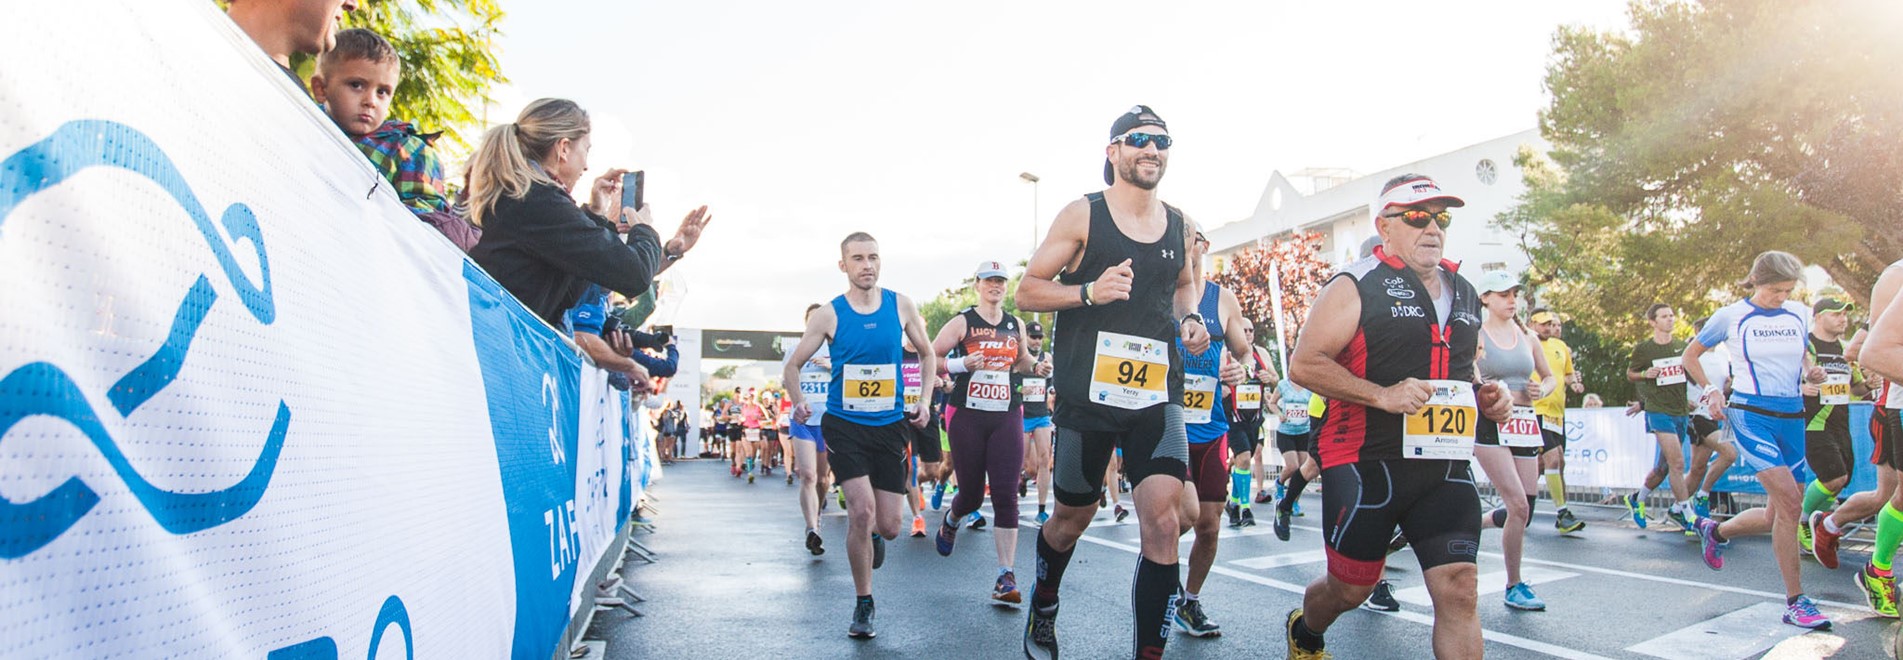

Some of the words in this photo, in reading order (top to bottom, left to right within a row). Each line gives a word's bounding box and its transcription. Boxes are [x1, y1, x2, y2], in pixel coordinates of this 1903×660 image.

[992, 262, 1000, 270] B
[971, 326, 997, 339] Lucy
[1752, 328, 1798, 338] ERDINGER
[979, 340, 1004, 349] TRI
[1117, 361, 1148, 387] 94
[801, 383, 829, 393] 2311
[859, 381, 881, 397] 62
[970, 383, 1009, 399] 2008
[1827, 385, 1846, 395] 104
[1245, 393, 1256, 401] 14
[1422, 407, 1465, 434] 120
[1500, 420, 1535, 434] 2107
